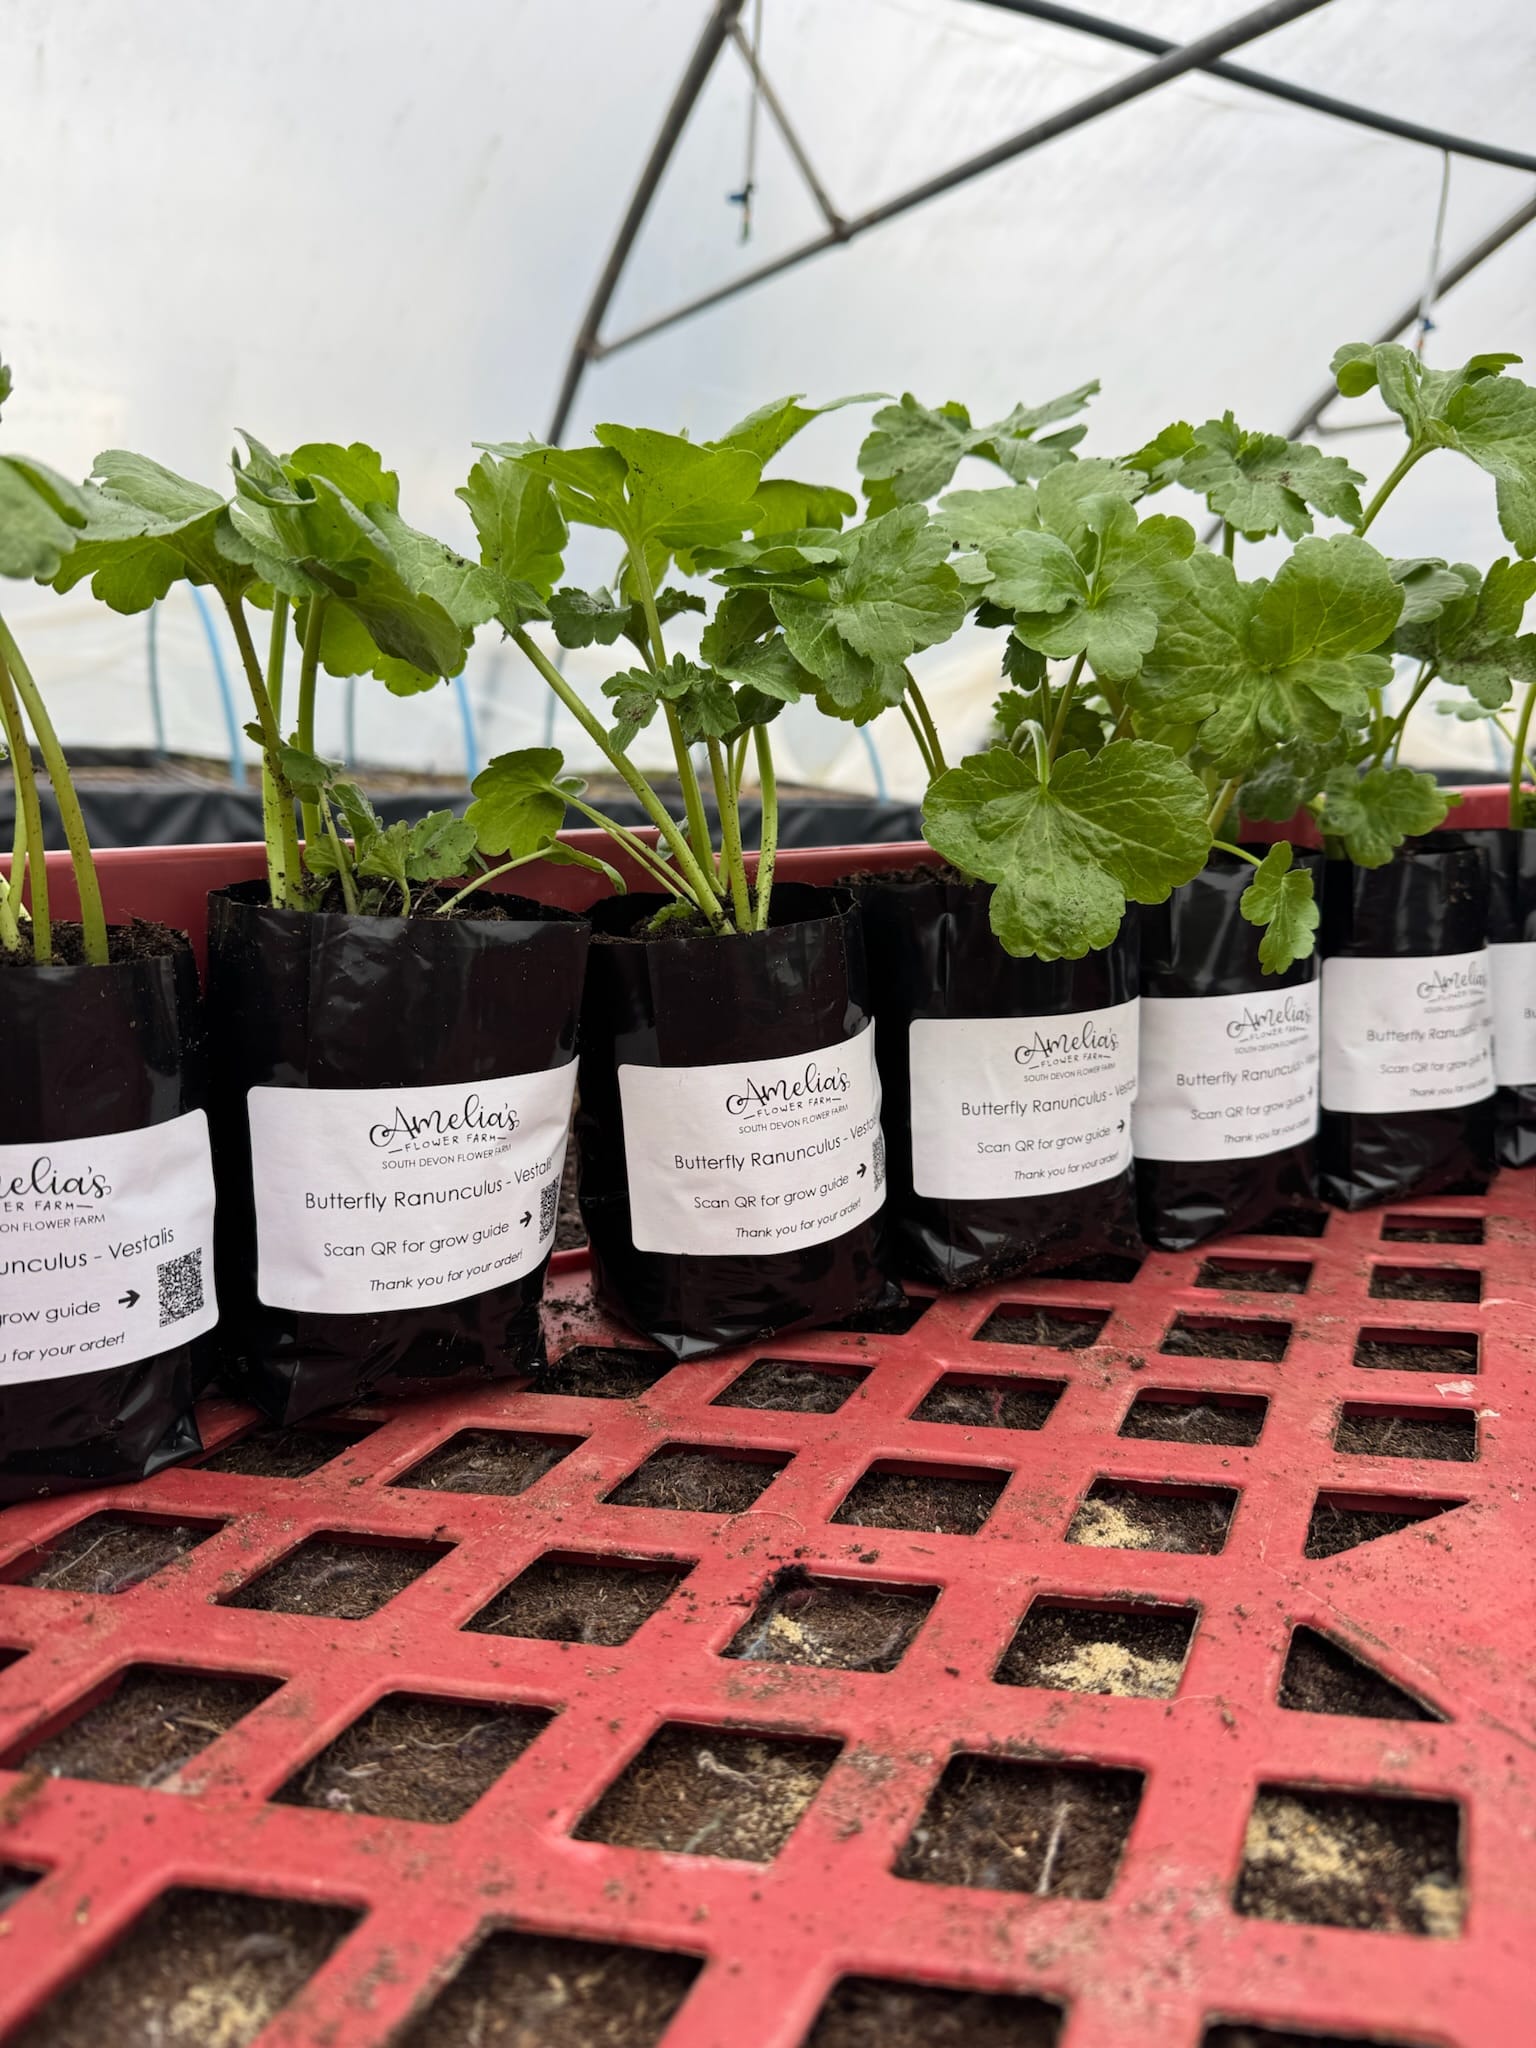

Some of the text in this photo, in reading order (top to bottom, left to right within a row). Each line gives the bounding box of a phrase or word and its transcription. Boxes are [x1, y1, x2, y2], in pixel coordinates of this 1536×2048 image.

[1014, 1021, 1118, 1065] Amelia's
[1041, 1053, 1079, 1067] FLOWER
[725, 1062, 850, 1116] Amelia's
[1024, 1074, 1049, 1082] SOUTH
[1050, 1071, 1075, 1080] DEVON
[1176, 1072, 1237, 1087] Butterfly
[757, 1097, 831, 1117] FLOWER FARM
[962, 1100, 1027, 1117] Butterfly
[1033, 1091, 1107, 1112] Ranunculus
[1190, 1107, 1222, 1120] Scan
[1225, 1106, 1243, 1118] QR
[369, 1094, 520, 1148] Amelia's
[739, 1104, 848, 1134] SOUTH DEVON FLOWER FARM
[405, 1133, 495, 1152] FLOWER FARM
[977, 1128, 1111, 1154] Scan QR for grow guide
[1224, 1134, 1253, 1143] Thank
[382, 1160, 415, 1169] SOUTH
[419, 1155, 454, 1167] DEVON
[458, 1150, 493, 1162] FLOWER
[675, 1155, 744, 1171] Butterfly
[751, 1137, 840, 1167] Ranunculus
[0, 1157, 111, 1199] elia's
[1014, 1169, 1045, 1180] Thank
[1048, 1168, 1065, 1179] you
[1068, 1164, 1080, 1173] for
[35, 1200, 73, 1211] FARM
[306, 1192, 387, 1212] Butterfly
[395, 1180, 502, 1207] Ranunculus
[694, 1176, 848, 1208] Scan QR for grow guide
[23, 1218, 70, 1231] FLOWER
[74, 1214, 105, 1226] FARM
[736, 1197, 861, 1238] Thank you for your order!
[0, 1252, 87, 1275] unculus
[109, 1227, 174, 1259] Vestalis
[324, 1223, 509, 1257] Scan QR for grow guide
[370, 1249, 522, 1291] Thank you for your order!
[0, 1301, 100, 1328] row guide
[13, 1349, 35, 1361] for
[40, 1344, 76, 1361] your
[80, 1332, 124, 1352] order!
